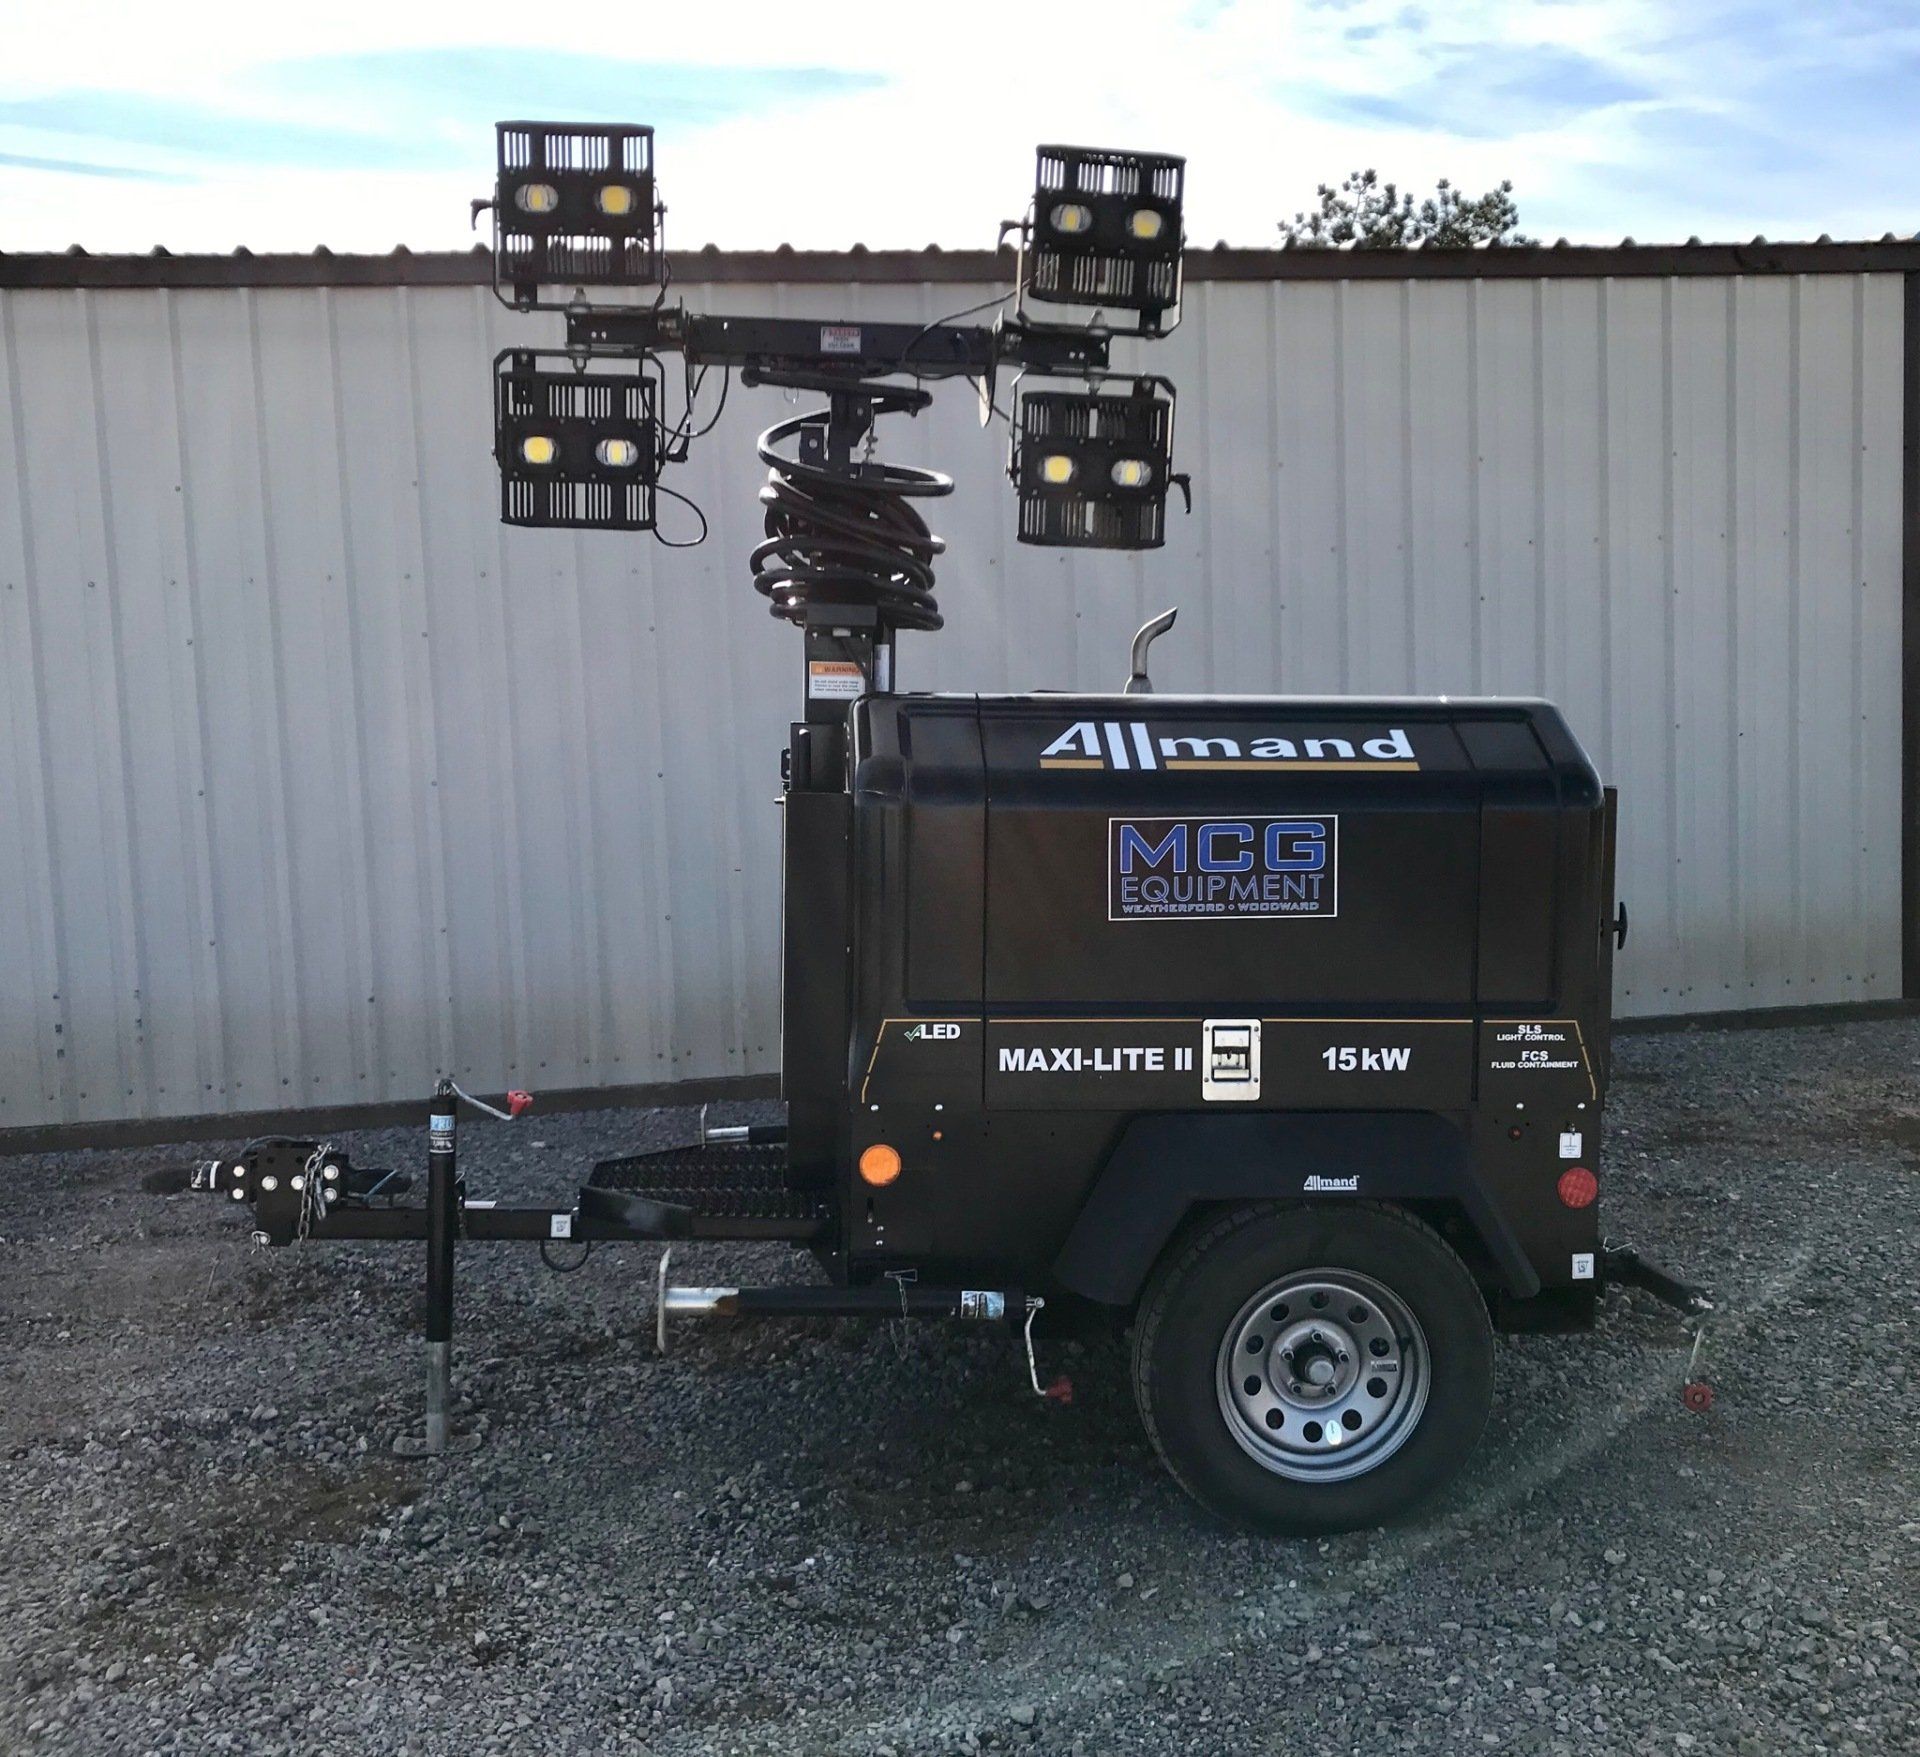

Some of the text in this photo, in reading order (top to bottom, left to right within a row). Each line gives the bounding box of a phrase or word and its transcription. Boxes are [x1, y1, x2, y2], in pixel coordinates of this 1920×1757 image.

[1040, 721, 1416, 770] Allmand
[1120, 822, 1326, 874] MCG
[1120, 873, 1325, 904] EQUIPMENT
[1122, 900, 1320, 914] WEATHERFORD WOODWARD
[919, 1023, 961, 1040] LED
[1496, 1033, 1566, 1041] LIGHT CONTROL
[1517, 1024, 1543, 1034] SLS
[998, 1047, 1194, 1072] MAXI-LITE II
[1521, 1050, 1549, 1061] FCS
[1491, 1061, 1579, 1069] FLUID CONTAINMENT
[1303, 1174, 1358, 1191] Allmand
